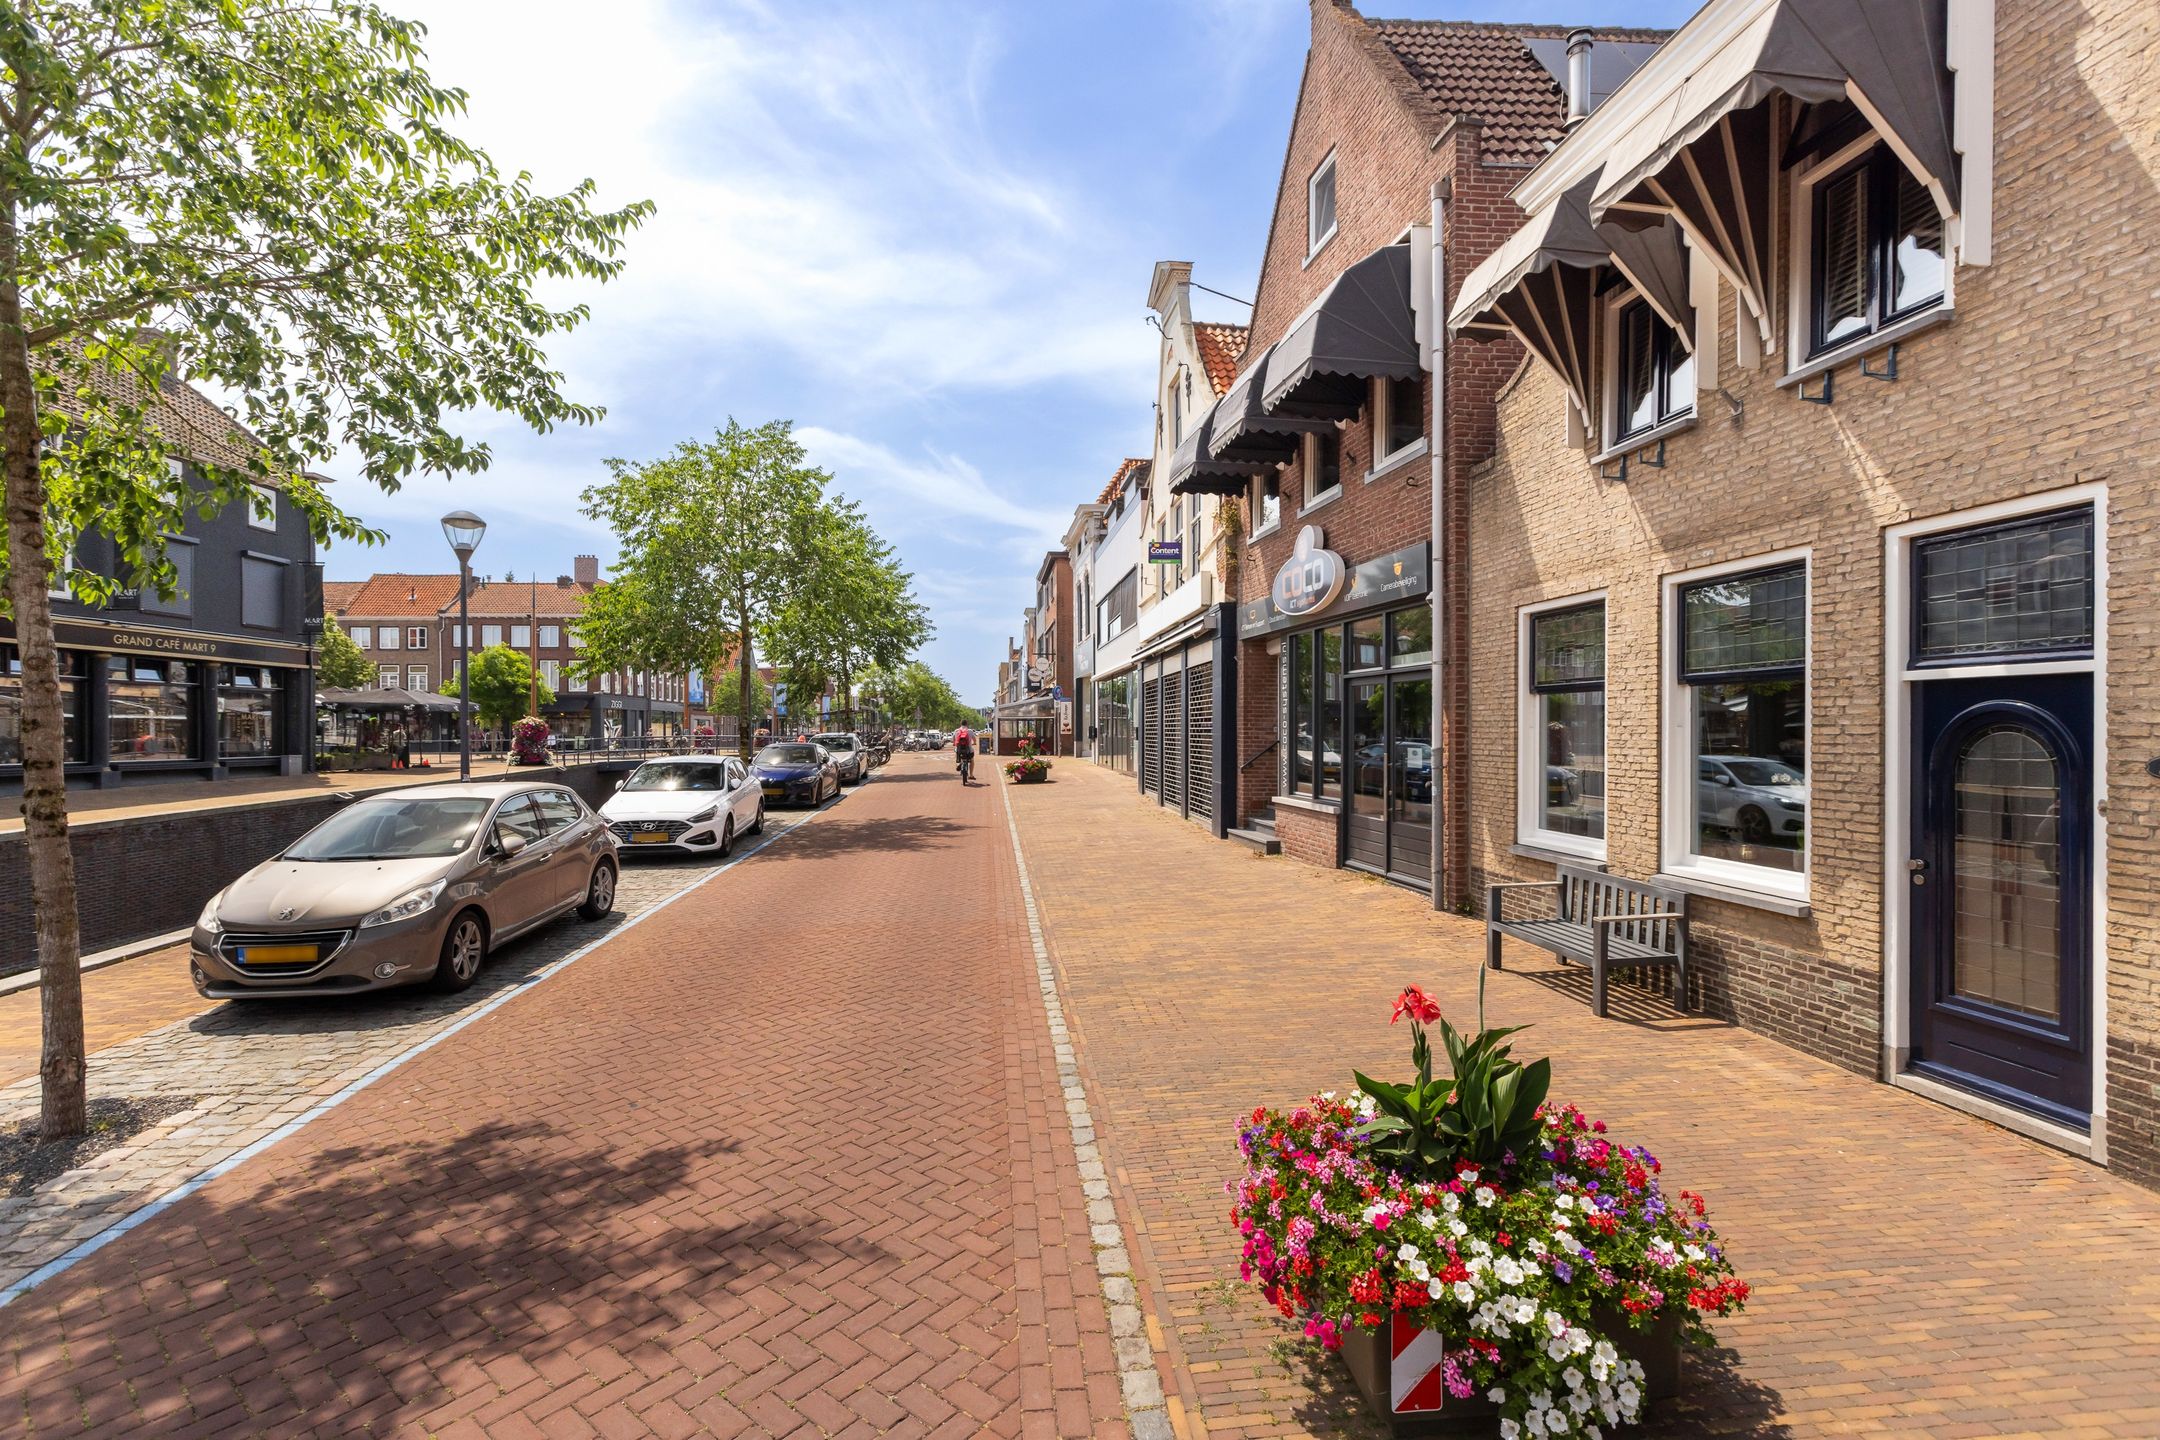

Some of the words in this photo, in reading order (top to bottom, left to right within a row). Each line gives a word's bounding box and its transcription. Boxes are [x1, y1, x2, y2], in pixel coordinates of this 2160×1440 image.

[1282, 558, 1324, 599] COCO
[113, 634, 153, 647] GRAND
[155, 638, 180, 650] CAFÉ
[183, 641, 208, 652] MART
[210, 644, 216, 653] 9
